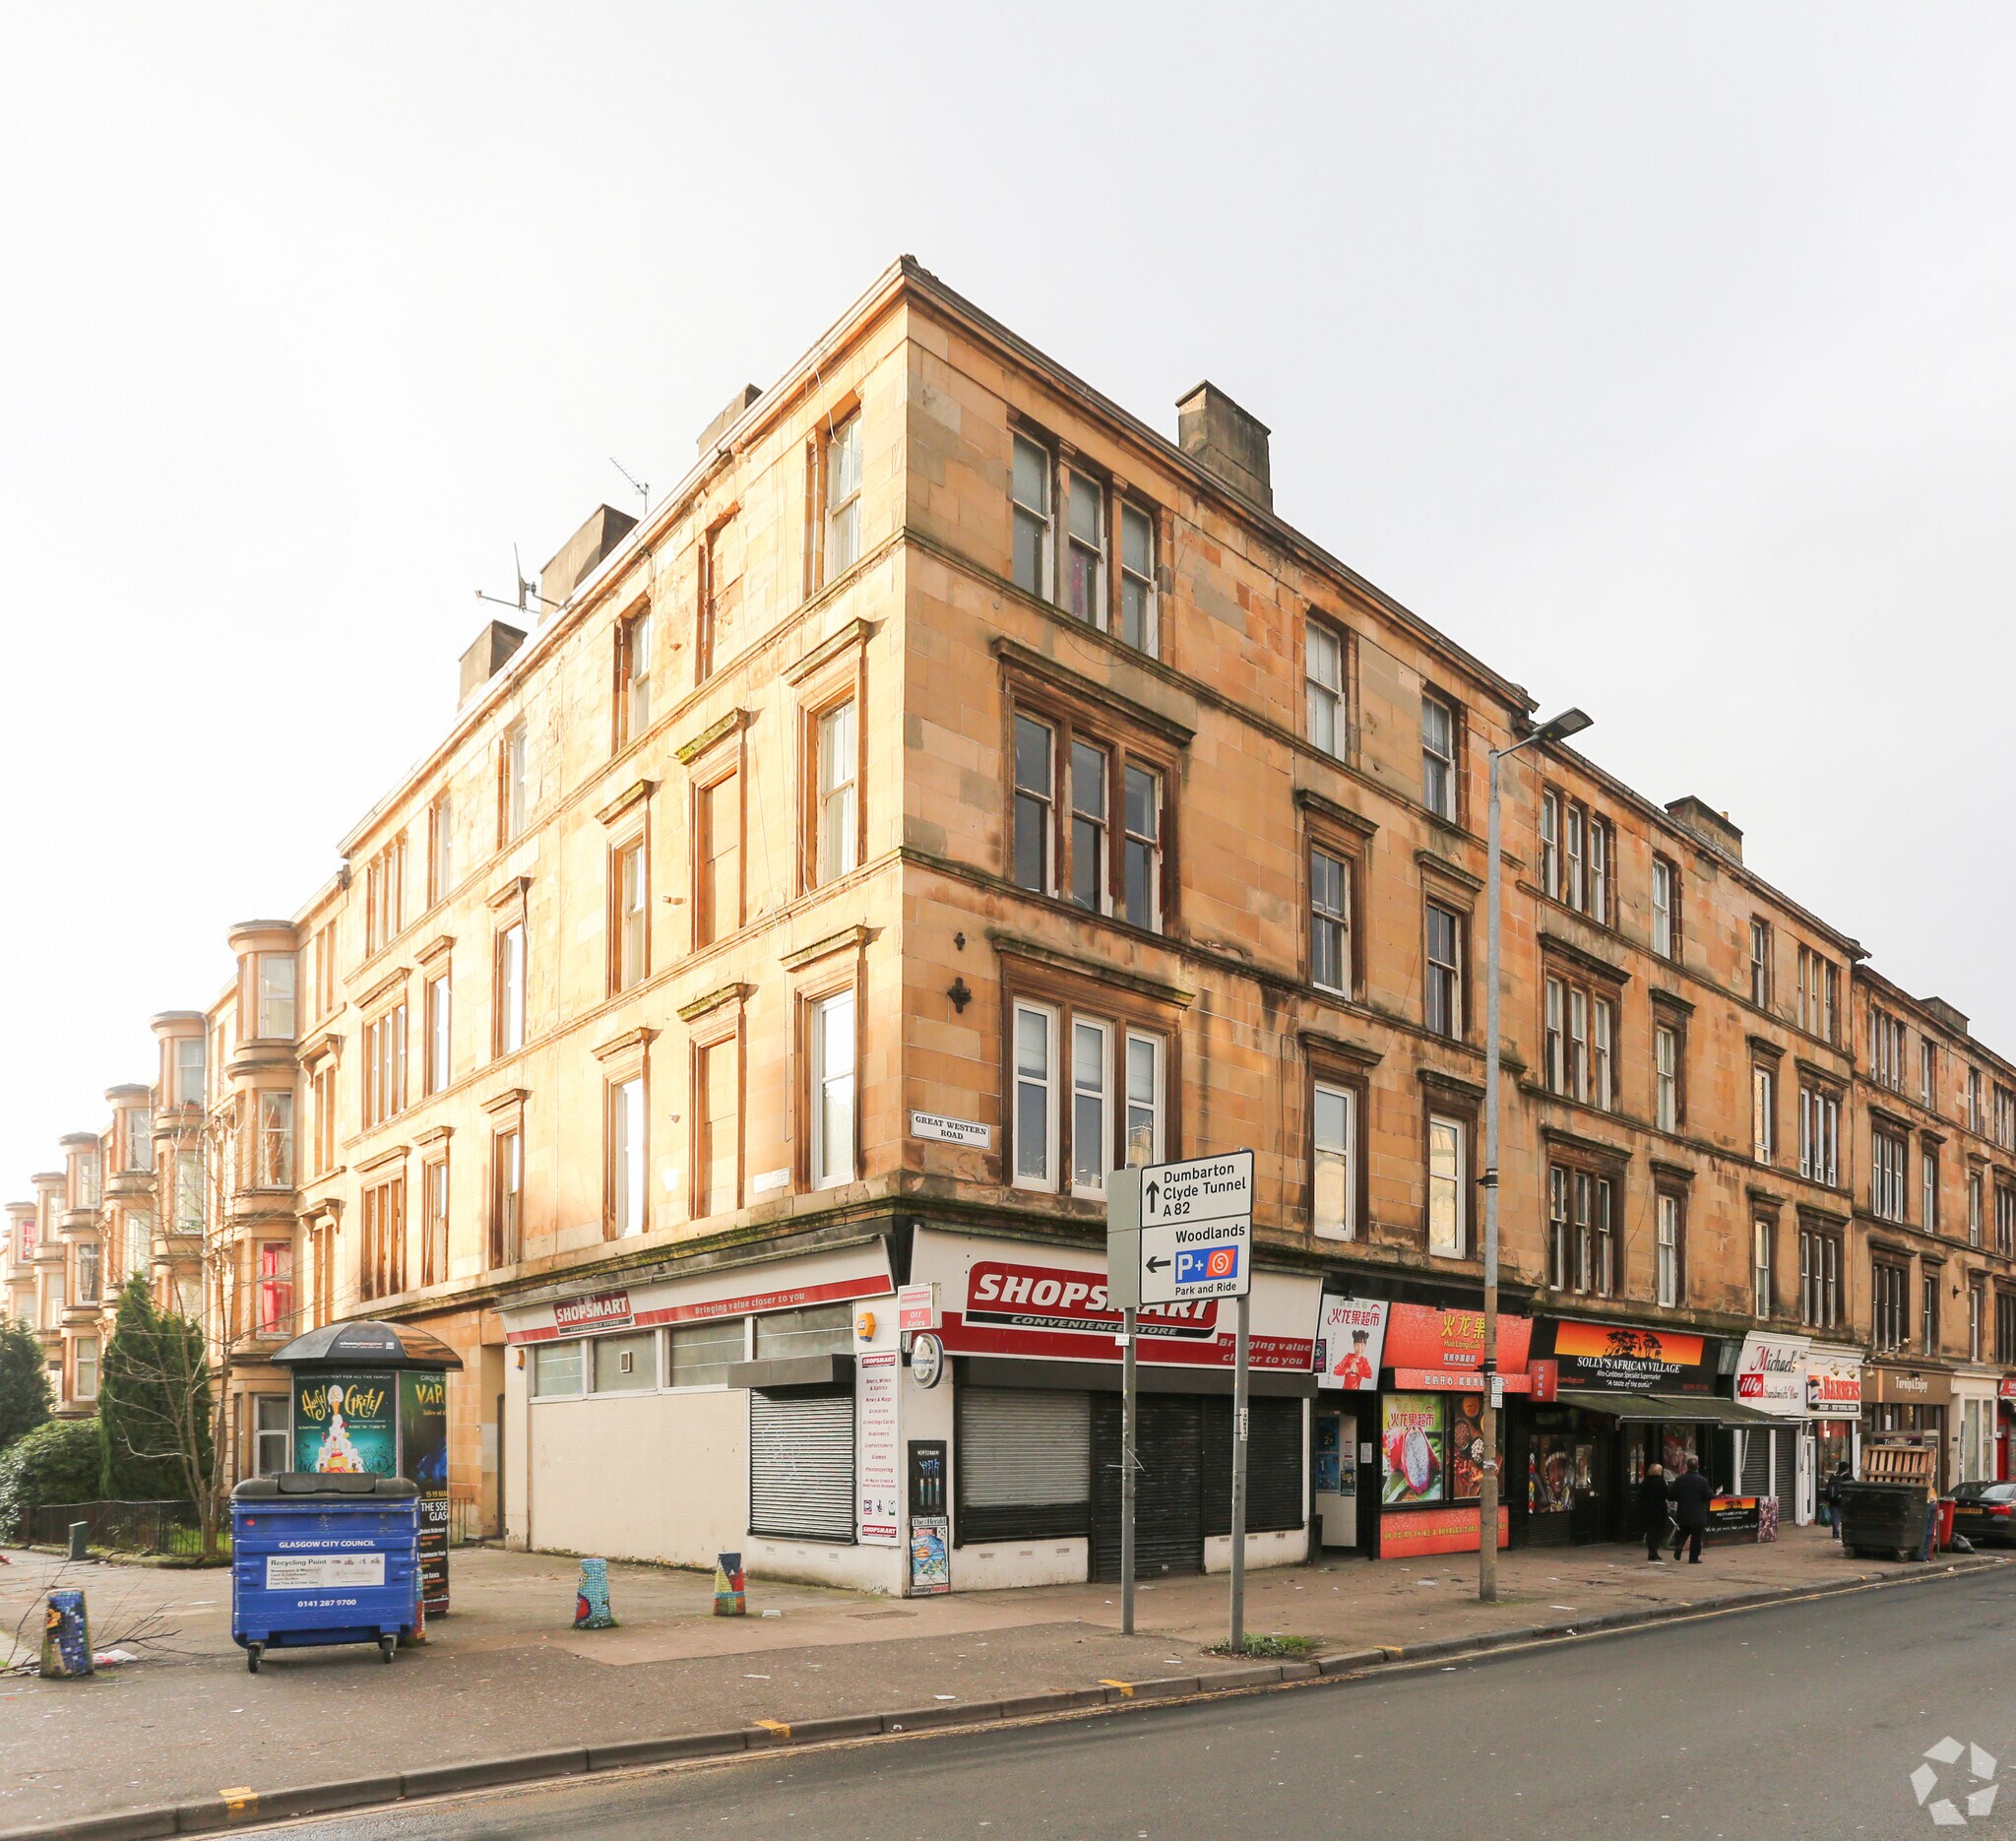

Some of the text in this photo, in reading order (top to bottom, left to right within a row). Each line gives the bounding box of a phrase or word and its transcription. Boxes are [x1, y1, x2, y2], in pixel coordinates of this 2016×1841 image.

[915, 1115, 986, 1135] GREAT WESTERN
[941, 1129, 964, 1140] ROAD
[1165, 1165, 1234, 1183] Dumbarton
[1164, 1176, 1246, 1200] Clyde Tunnel
[1175, 1224, 1245, 1242] Woodlands
[902, 1292, 930, 1301] SHOPSMART
[1175, 1282, 1236, 1296] Park and Ride
[556, 1297, 627, 1323] SHOPSMART
[694, 1293, 805, 1315] Bringing value closer to you
[1011, 1315, 1124, 1332] CONVENIENCE
[1219, 1339, 1277, 1352] Brging
[863, 1355, 896, 1365] SHOPSMART
[1265, 1355, 1279, 1364] to
[1577, 1356, 1681, 1373] SOLLY'S AFRICAN VILLAGE
[1750, 1346, 1797, 1372] Michael's
[1596, 1369, 1623, 1378] Afro-Caribbean
[1640, 1371, 1662, 1380] Supermarket
[1741, 1377, 1762, 1395] illy
[420, 1501, 448, 1512] THE SSE
[862, 1526, 896, 1535] SHOPSMART
